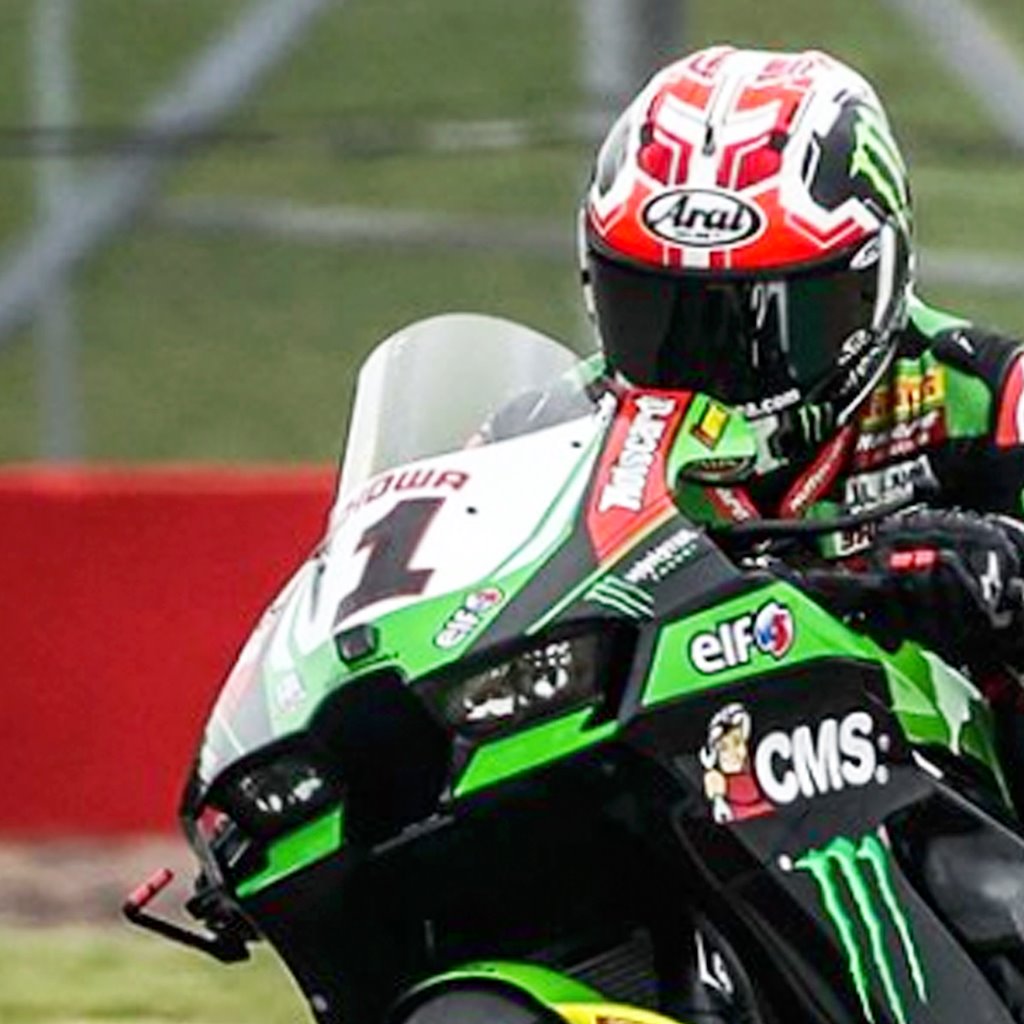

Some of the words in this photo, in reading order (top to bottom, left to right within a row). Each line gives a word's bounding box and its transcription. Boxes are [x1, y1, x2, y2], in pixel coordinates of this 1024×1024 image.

[335, 496, 449, 630] 1
[690, 615, 755, 674] elf
[755, 711, 877, 804] CMS
